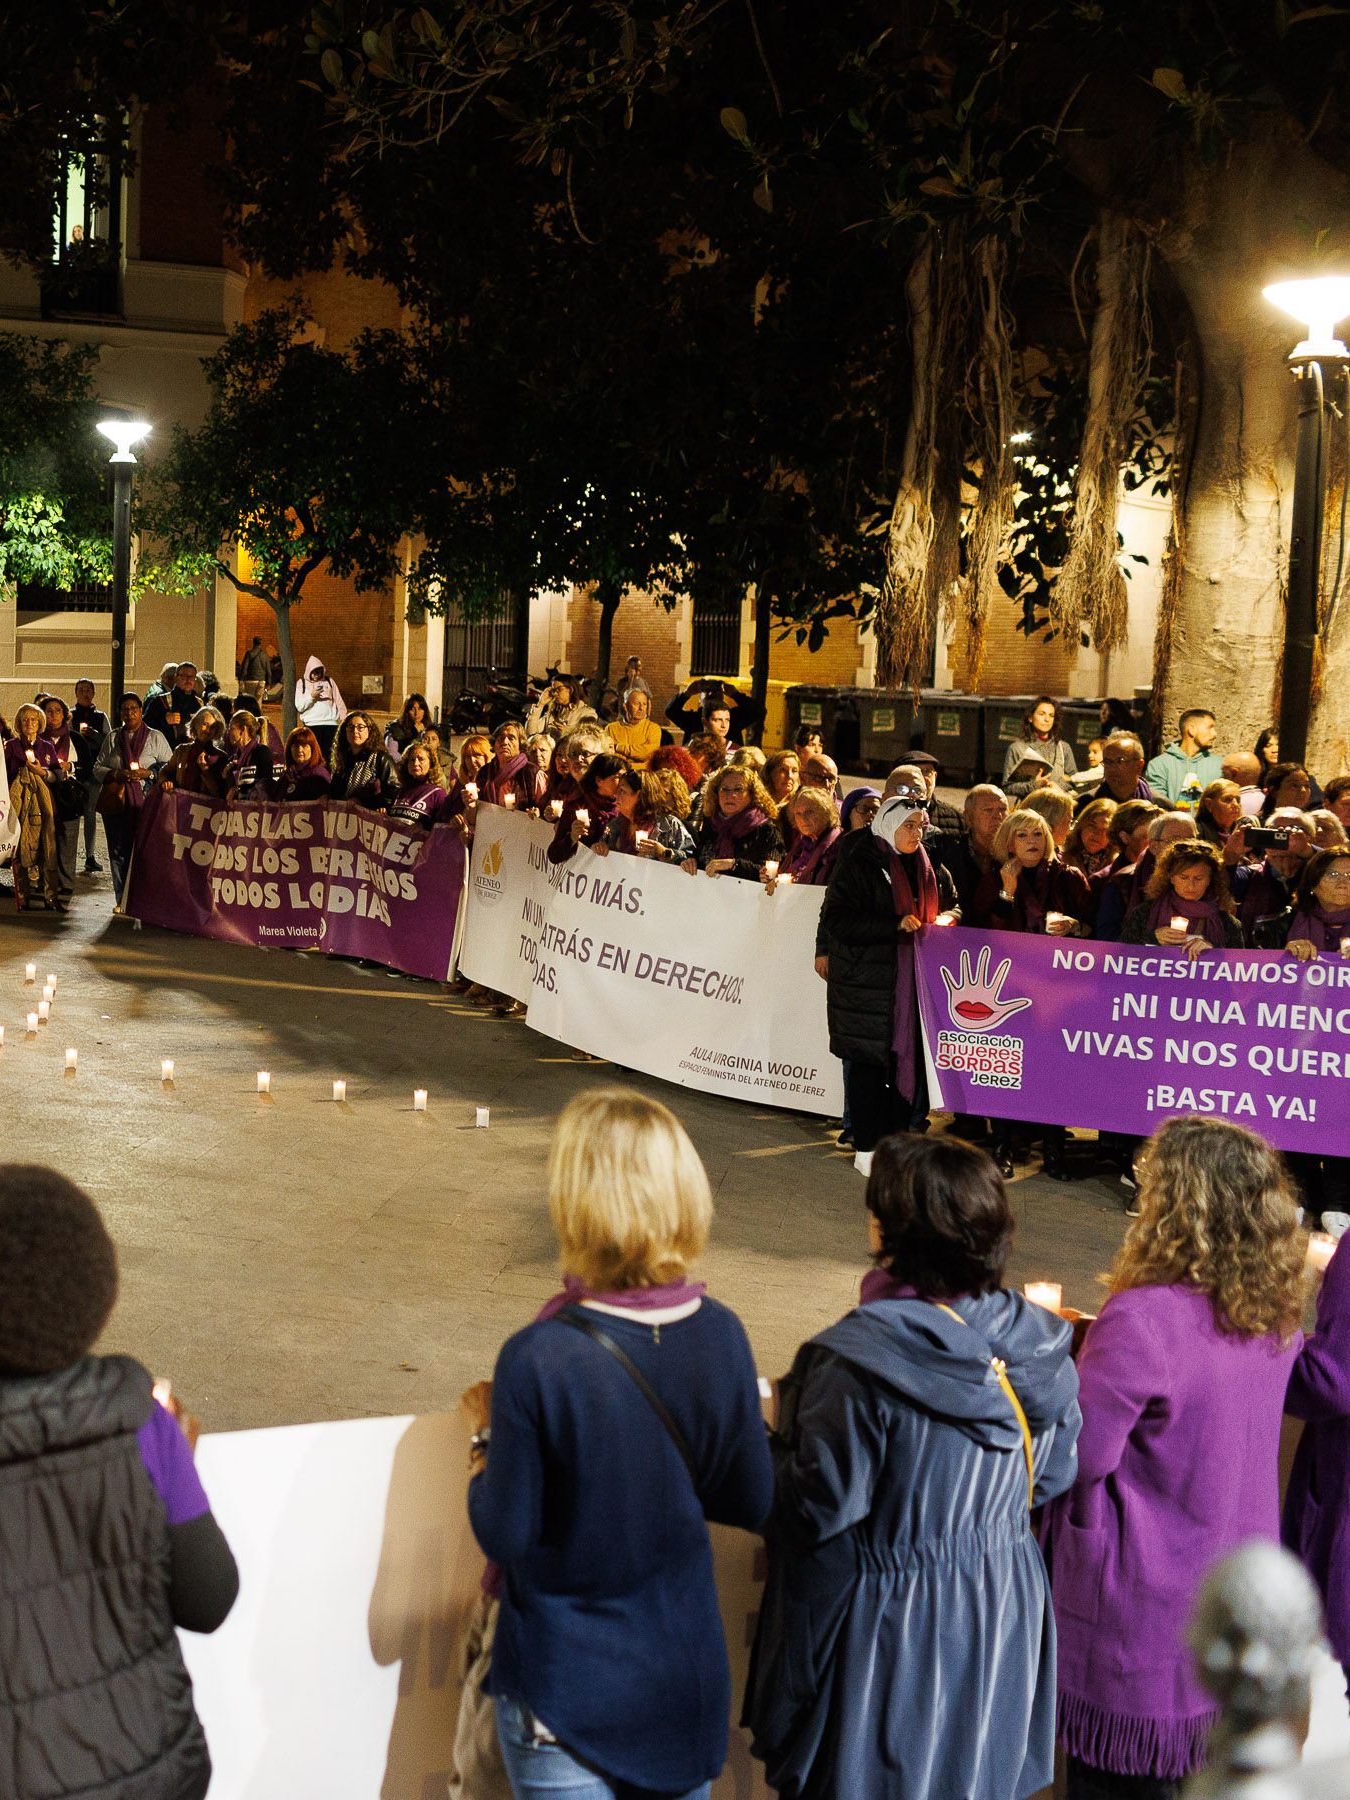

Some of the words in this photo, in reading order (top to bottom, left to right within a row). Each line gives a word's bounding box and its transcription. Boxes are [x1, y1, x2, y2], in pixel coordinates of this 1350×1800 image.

[261, 811, 314, 840] LAS
[252, 847, 300, 875] LOS
[475, 876, 501, 889] ATENEO
[590, 878, 645, 916] MÁS.
[211, 877, 281, 909] TODOS
[327, 883, 392, 927] DÍAS
[259, 925, 286, 937] Marea
[286, 925, 318, 937] Violeta
[539, 921, 594, 963] ATRÁS
[597, 942, 631, 974] EN
[634, 953, 743, 1005] DERECHOS.
[1052, 949, 1095, 972] NO
[1103, 954, 1298, 984] NECESITAMOS
[1306, 964, 1350, 988] OIR
[1112, 992, 1158, 1022] ¡NI
[1169, 996, 1246, 1026] UNA
[689, 1046, 712, 1063] AULA
[713, 1052, 763, 1073] VIRGINIA
[768, 1061, 818, 1081] WOOLF
[1061, 1028, 1154, 1061] VIVAS
[1164, 1038, 1238, 1068] NOS
[1248, 1044, 1350, 1079] QUER
[678, 1059, 702, 1073] ESPACIO
[701, 1065, 736, 1081] FEMINISTA
[738, 1074, 752, 1085] DEL
[753, 1077, 788, 1090] ATENEO
[789, 1083, 801, 1093] DE
[802, 1084, 826, 1098] JEREZ
[1146, 1084, 1257, 1117] ¡BASTA
[1266, 1094, 1317, 1123] YA!
